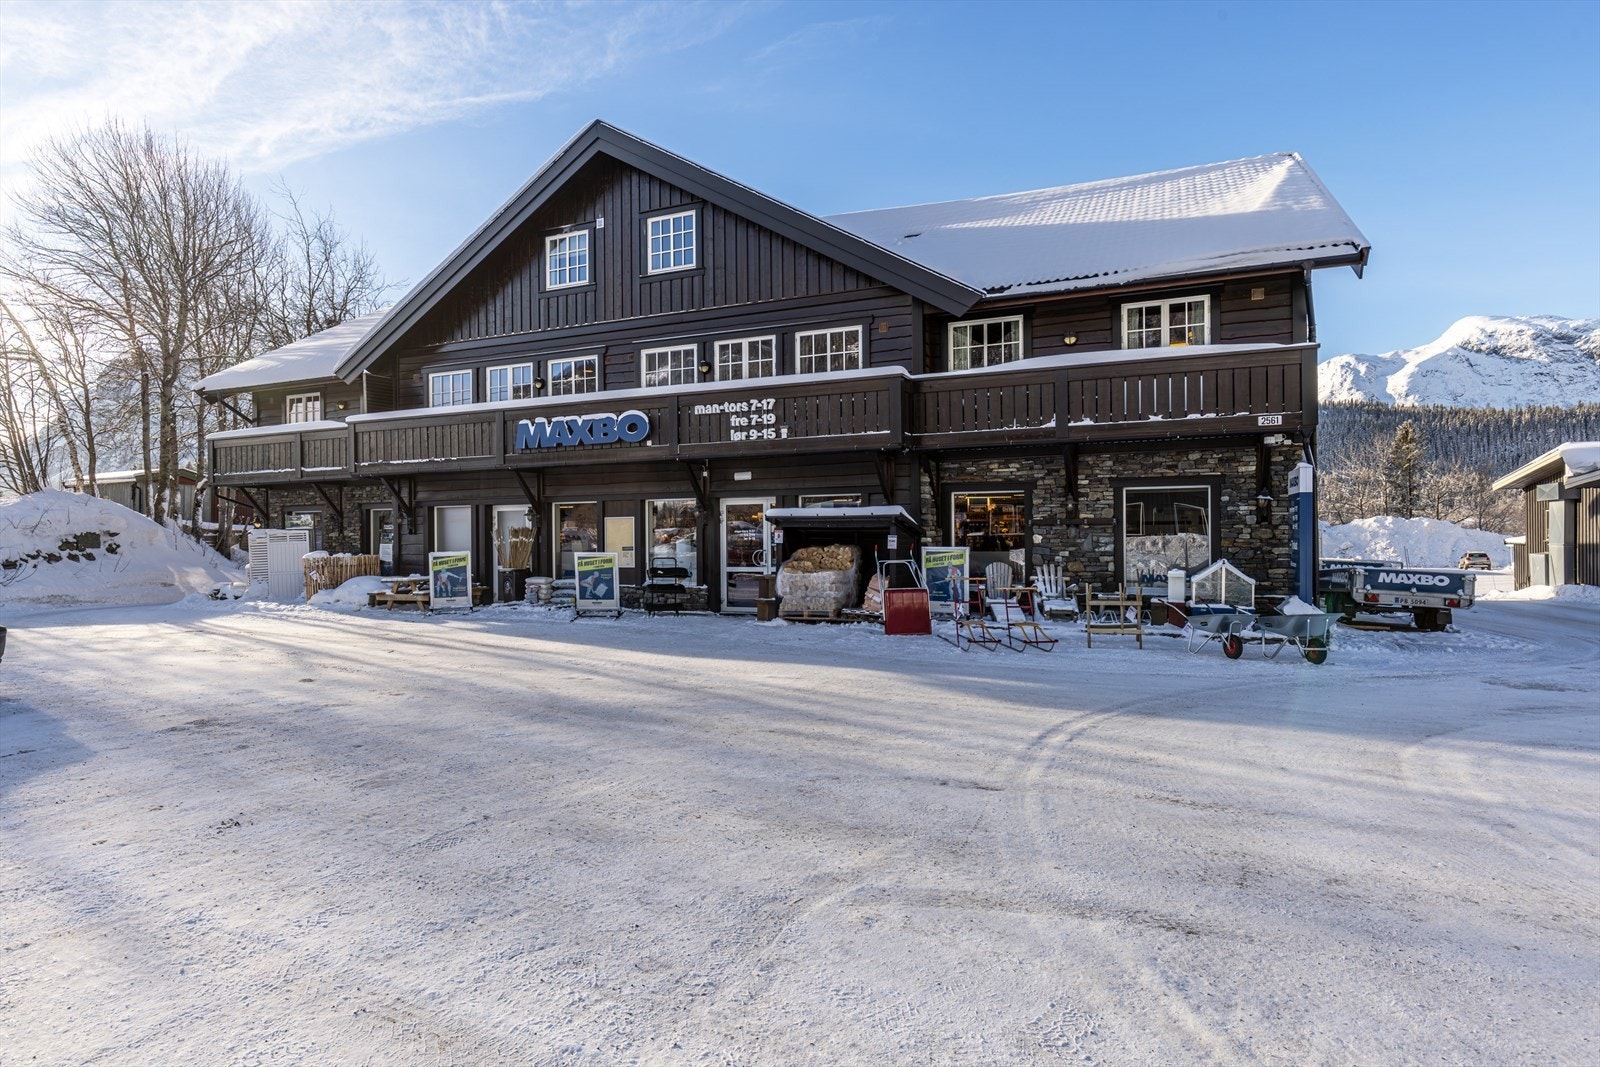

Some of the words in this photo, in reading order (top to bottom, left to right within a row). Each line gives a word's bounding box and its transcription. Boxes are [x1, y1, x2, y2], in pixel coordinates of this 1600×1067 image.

[694, 400, 749, 415] man-tors
[750, 398, 776, 411] 7-17
[730, 416, 749, 426] fre
[750, 414, 776, 425] 7-19
[1261, 416, 1279, 425] 2561
[515, 411, 650, 449] MAXBO
[730, 429, 749, 441] lør
[750, 429, 776, 440] 9-15
[1378, 572, 1450, 587] MAXBO
